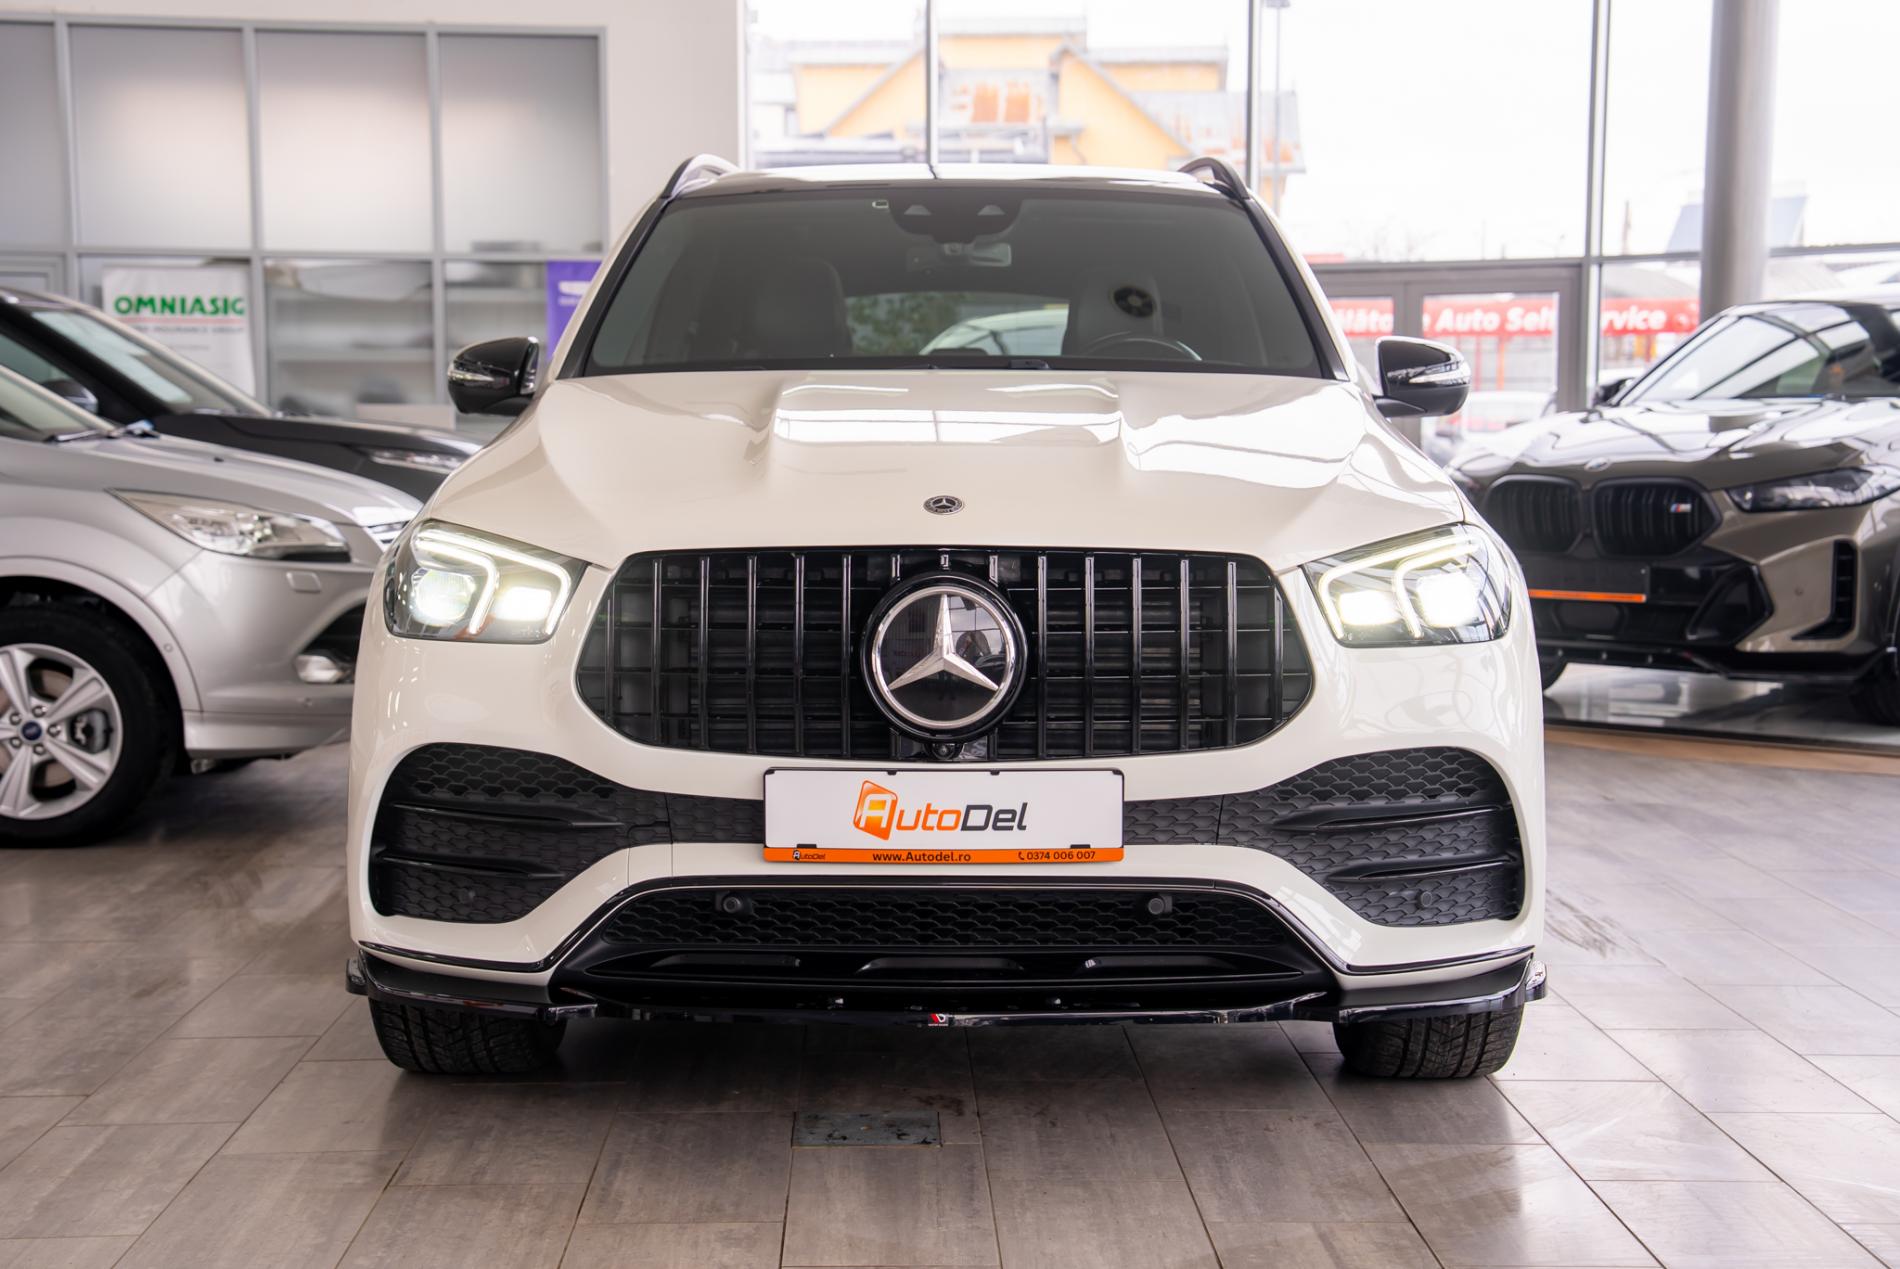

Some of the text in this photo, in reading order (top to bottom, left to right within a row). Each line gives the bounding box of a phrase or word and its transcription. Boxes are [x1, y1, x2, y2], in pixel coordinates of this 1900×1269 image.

[1434, 308, 1500, 332] Auto
[854, 780, 1027, 840] AutoDel
[872, 851, 972, 862] www.Autodel.ro
[1026, 851, 1095, 860] 0374 006 007
